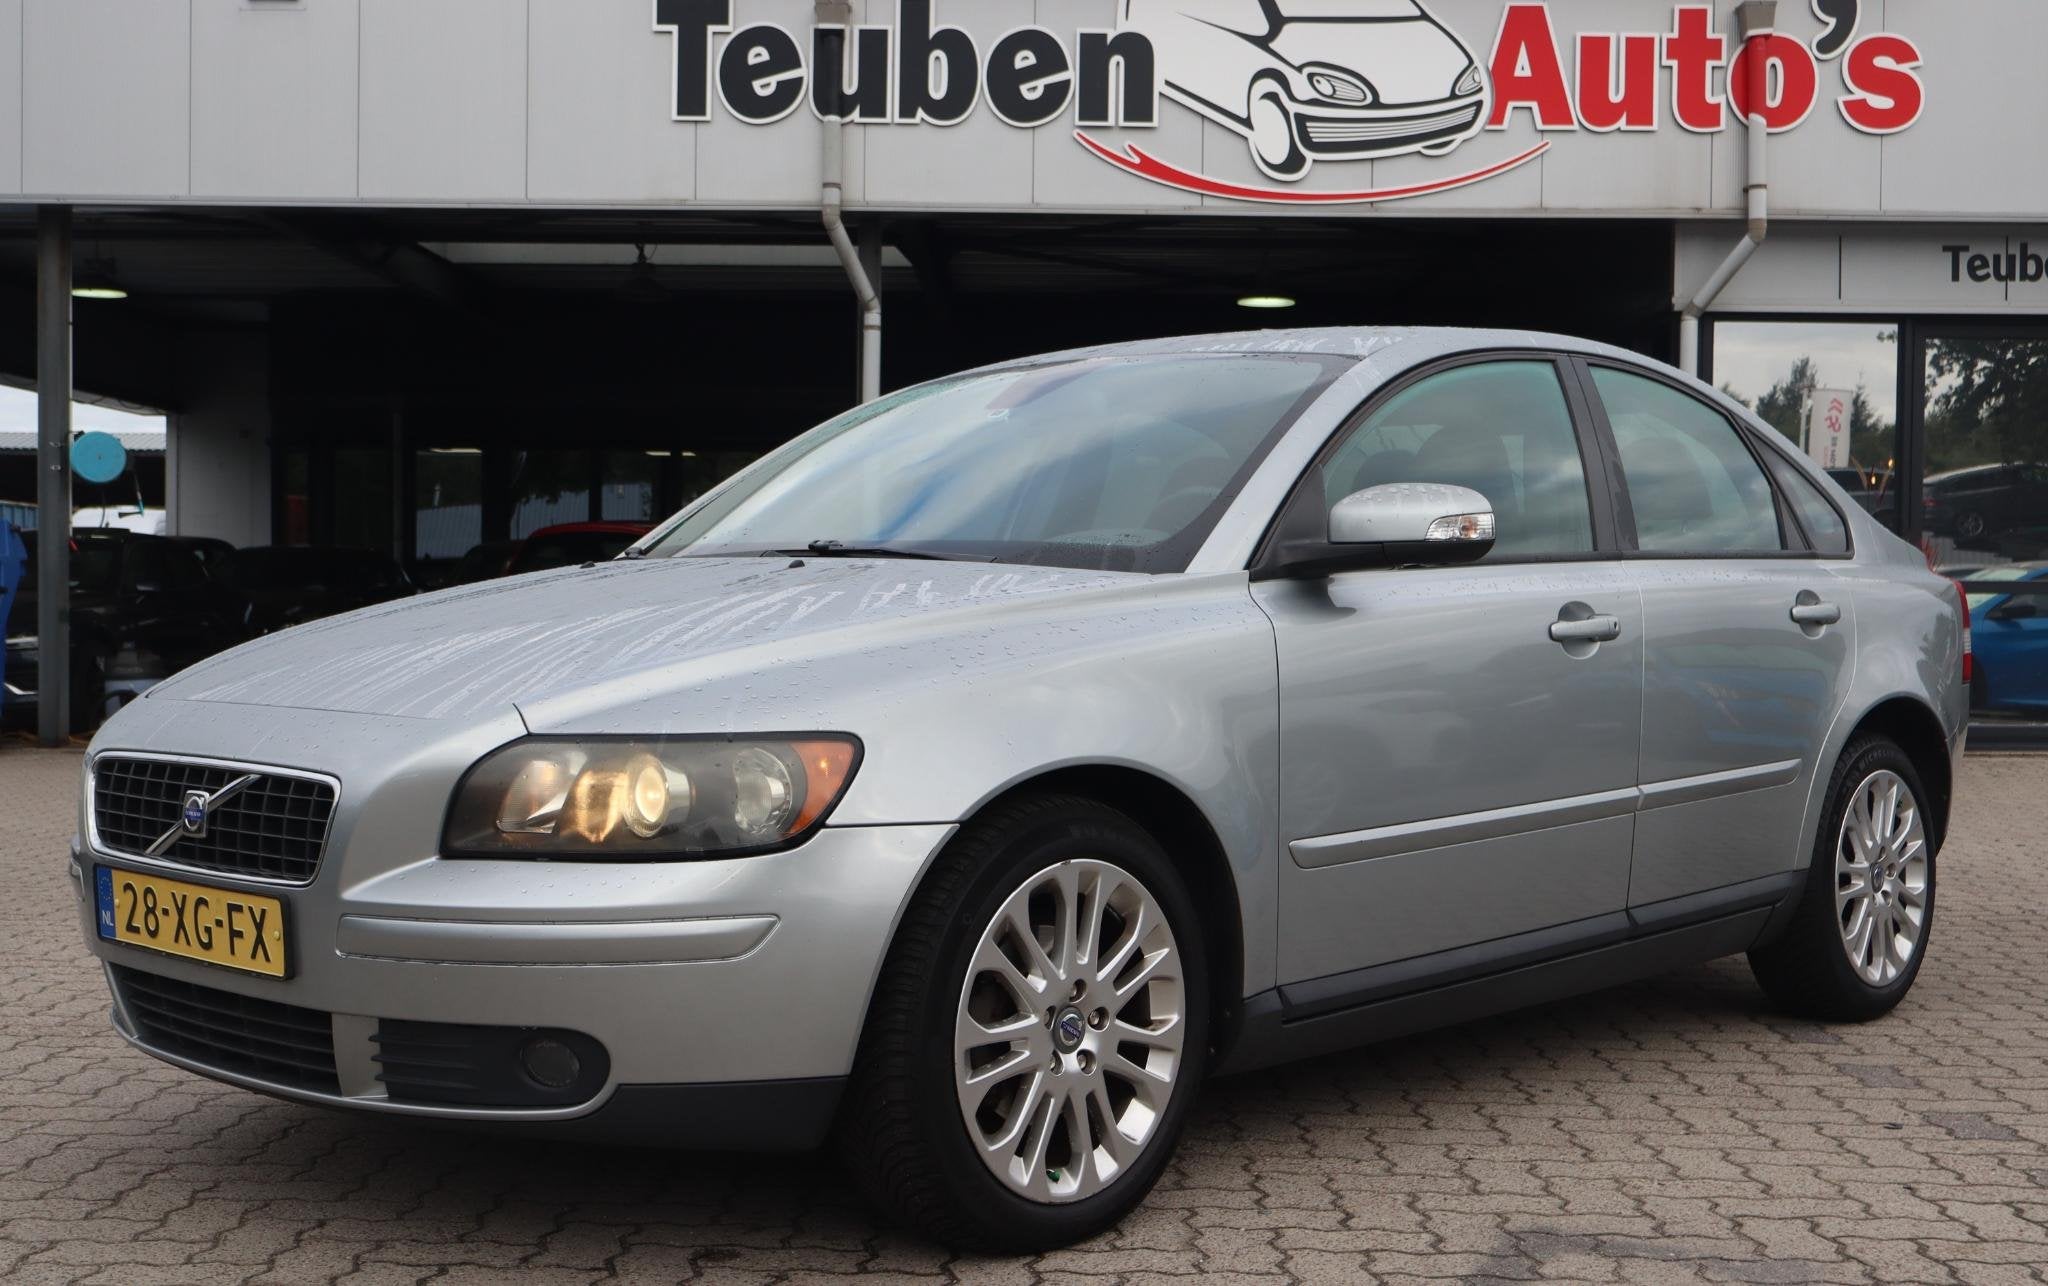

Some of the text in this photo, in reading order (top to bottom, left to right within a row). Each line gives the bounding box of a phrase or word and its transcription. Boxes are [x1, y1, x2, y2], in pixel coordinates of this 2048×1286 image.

[654, 0, 1924, 133] Teuben Auto's
[1942, 243, 2048, 282] Teub
[102, 910, 114, 926] NL
[123, 881, 271, 962] 28-XG-FX
